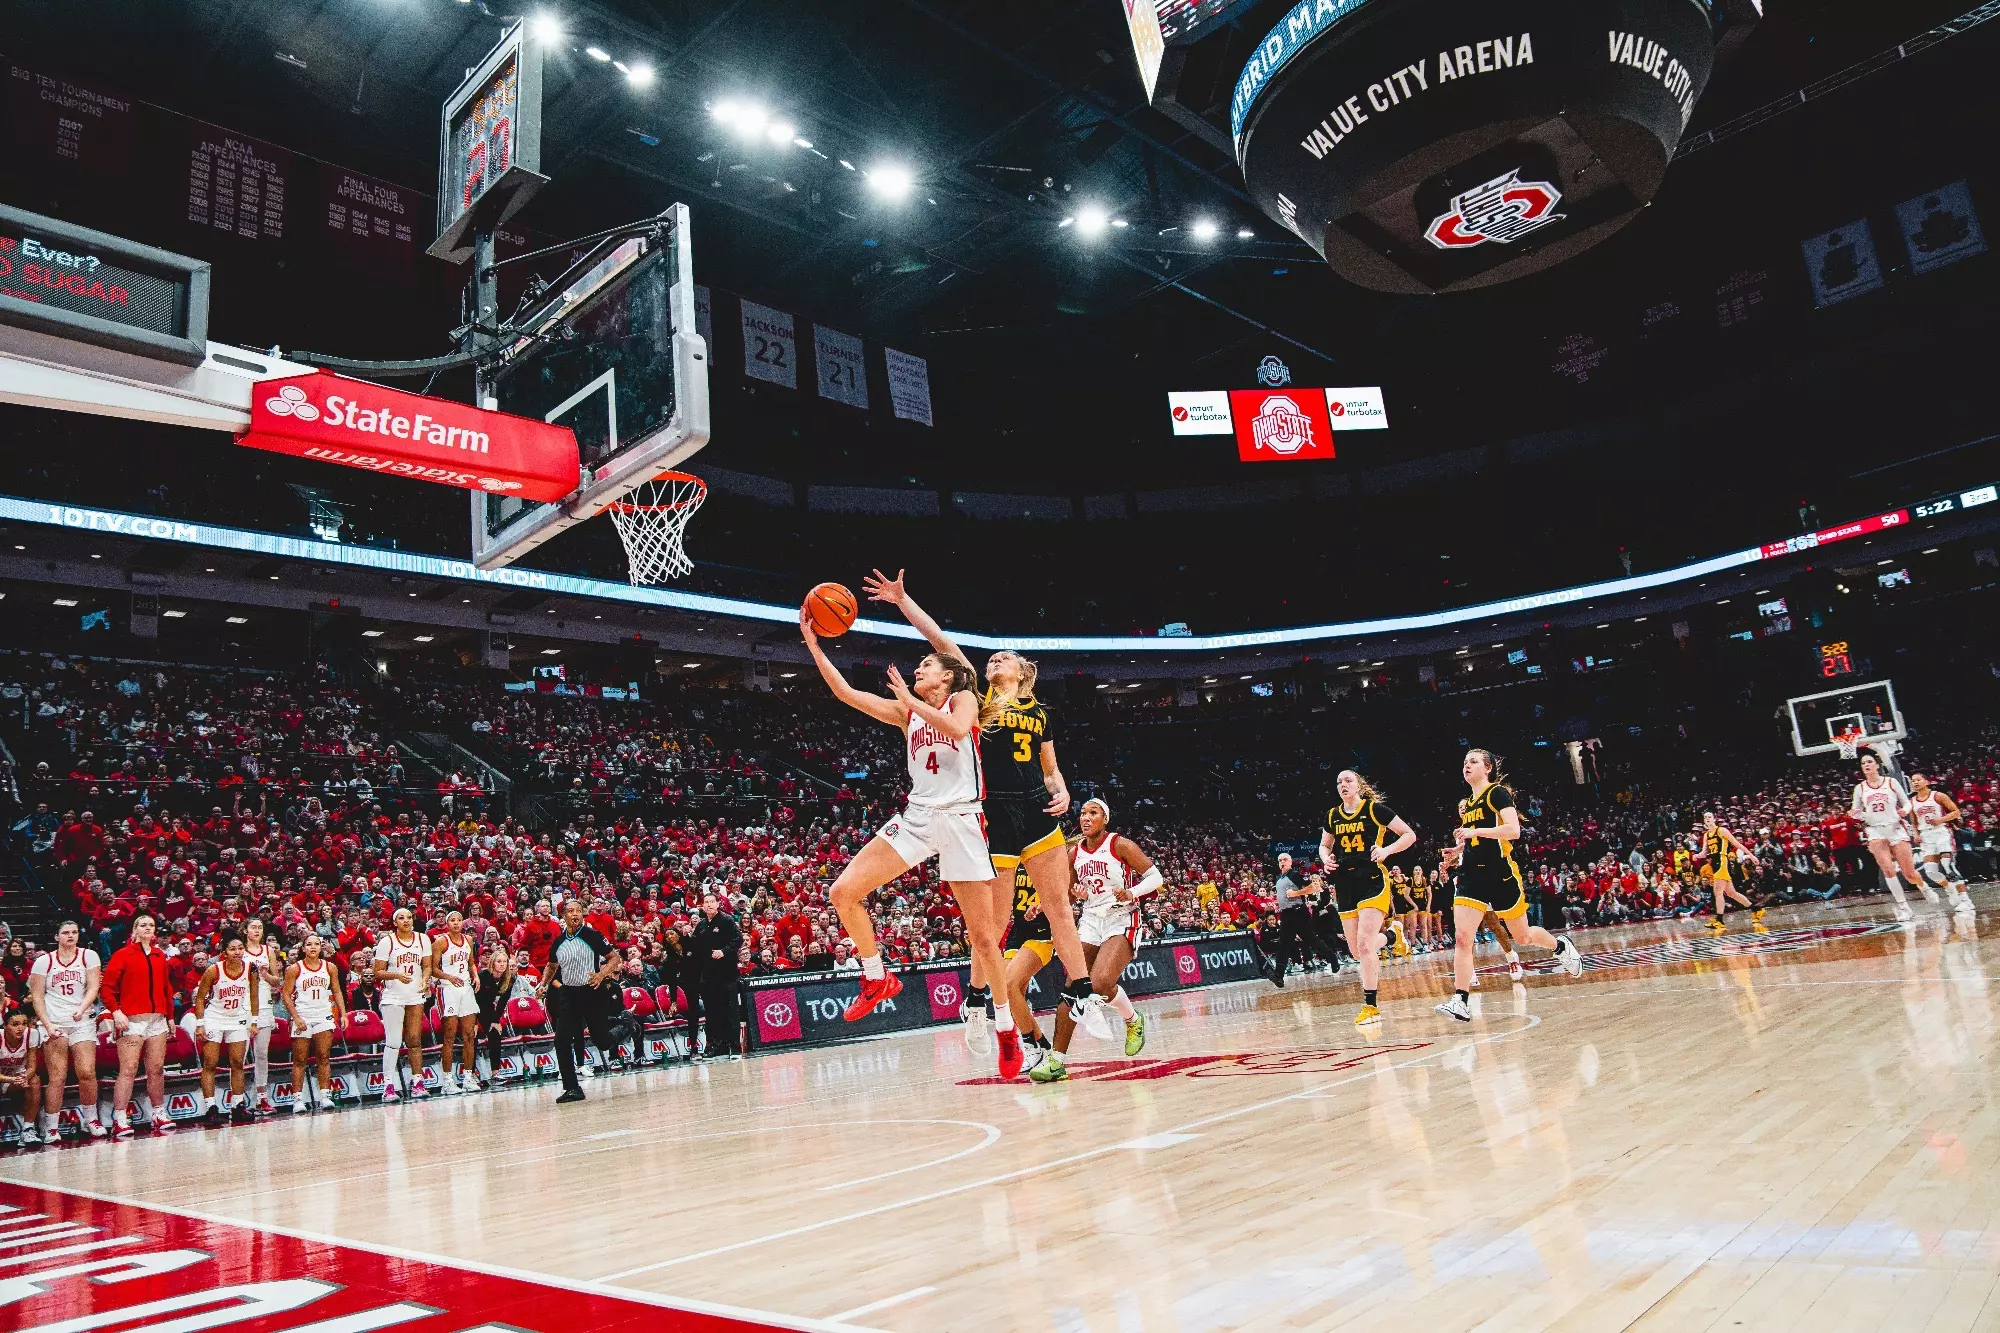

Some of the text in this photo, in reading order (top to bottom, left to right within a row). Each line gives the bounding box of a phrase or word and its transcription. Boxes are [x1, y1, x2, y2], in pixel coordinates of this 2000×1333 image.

[1232, 0, 1344, 132] HYBRID MA
[1608, 30, 1692, 104] VALUE CITY
[11, 65, 130, 112] BIG TEN TOURNAMENT
[1300, 33, 1533, 159] VALUE CITY ARENA
[40, 89, 104, 117] CHAMPIONS
[59, 117, 84, 131] 2007
[200, 141, 277, 174] APPEARANCES
[224, 137, 254, 156] NCAA
[337, 184, 405, 215] APPEARANCES
[343, 175, 398, 203] FINAL FOUR
[23, 238, 101, 273] Ever?
[22, 263, 129, 307] SUGAR
[744, 316, 794, 339] JACKSON
[754, 335, 787, 368] 22
[820, 342, 863, 363] TURNER
[828, 358, 855, 389] 21
[1190, 412, 1228, 422] turbotax
[1347, 408, 1382, 416] turbotax
[323, 394, 490, 453] State Farm
[303, 447, 477, 485] State Farm
[1915, 499, 1954, 518] 5:22
[49, 506, 197, 542] 10TV.COM
[1881, 513, 1900, 527] 50
[1817, 525, 1863, 542] OHIO STATE
[1505, 588, 1584, 613] 10TV.COM
[997, 638, 1072, 650] 10TV.COM
[1207, 632, 1283, 649] 10TV.COM
[1822, 655, 1850, 677] 27
[998, 710, 1043, 736] IOWA
[1013, 732, 1032, 762] 3
[926, 751, 940, 775] 4
[1871, 803, 1884, 813] 23
[1335, 821, 1365, 833] IOWA
[1340, 834, 1365, 853] 44
[458, 963, 464, 974] 2
[1201, 948, 1254, 970] TOYOTA
[402, 965, 413, 976] 14
[749, 974, 822, 987] AMERICAN ELECTRIC POWER
[60, 983, 74, 996] 15
[310, 988, 319, 1000] 11
[223, 999, 238, 1009] 20
